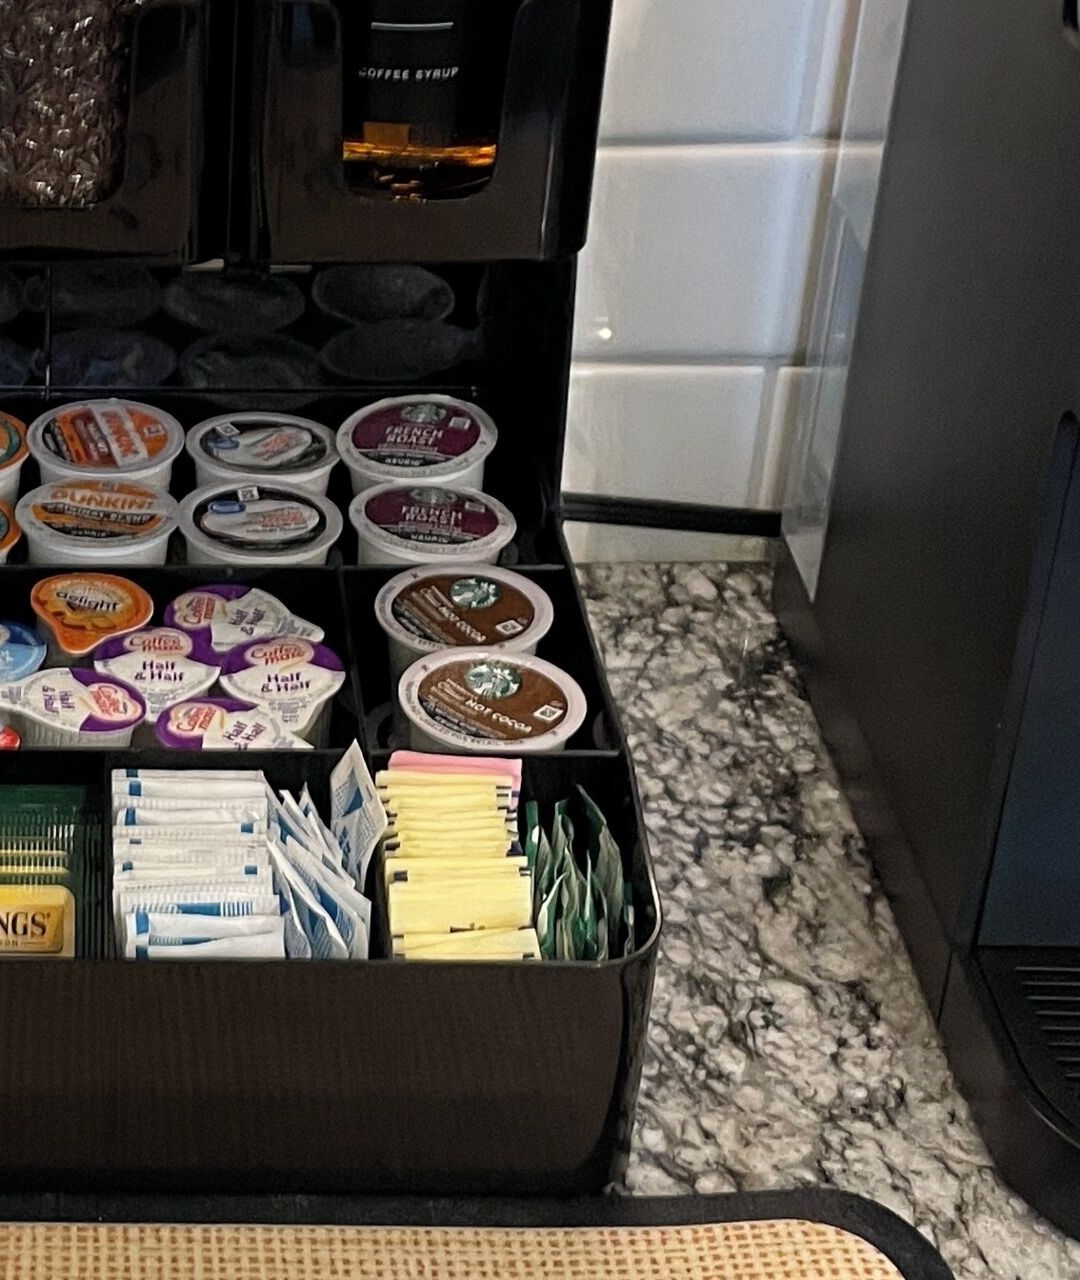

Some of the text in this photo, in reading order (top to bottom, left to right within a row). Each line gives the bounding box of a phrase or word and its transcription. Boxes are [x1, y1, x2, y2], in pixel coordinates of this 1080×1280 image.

[415, 66, 459, 79] SYRUP
[385, 426, 444, 439] FRENCH
[386, 434, 437, 445] ROAST
[56, 591, 118, 610] delight
[142, 660, 176, 671] Half
[134, 671, 184, 682] & Half
[267, 672, 302, 683] Half
[261, 681, 311, 693] & Half
[492, 712, 533, 734] COCOA
[223, 721, 248, 741] Half
[242, 722, 267, 742] Half
